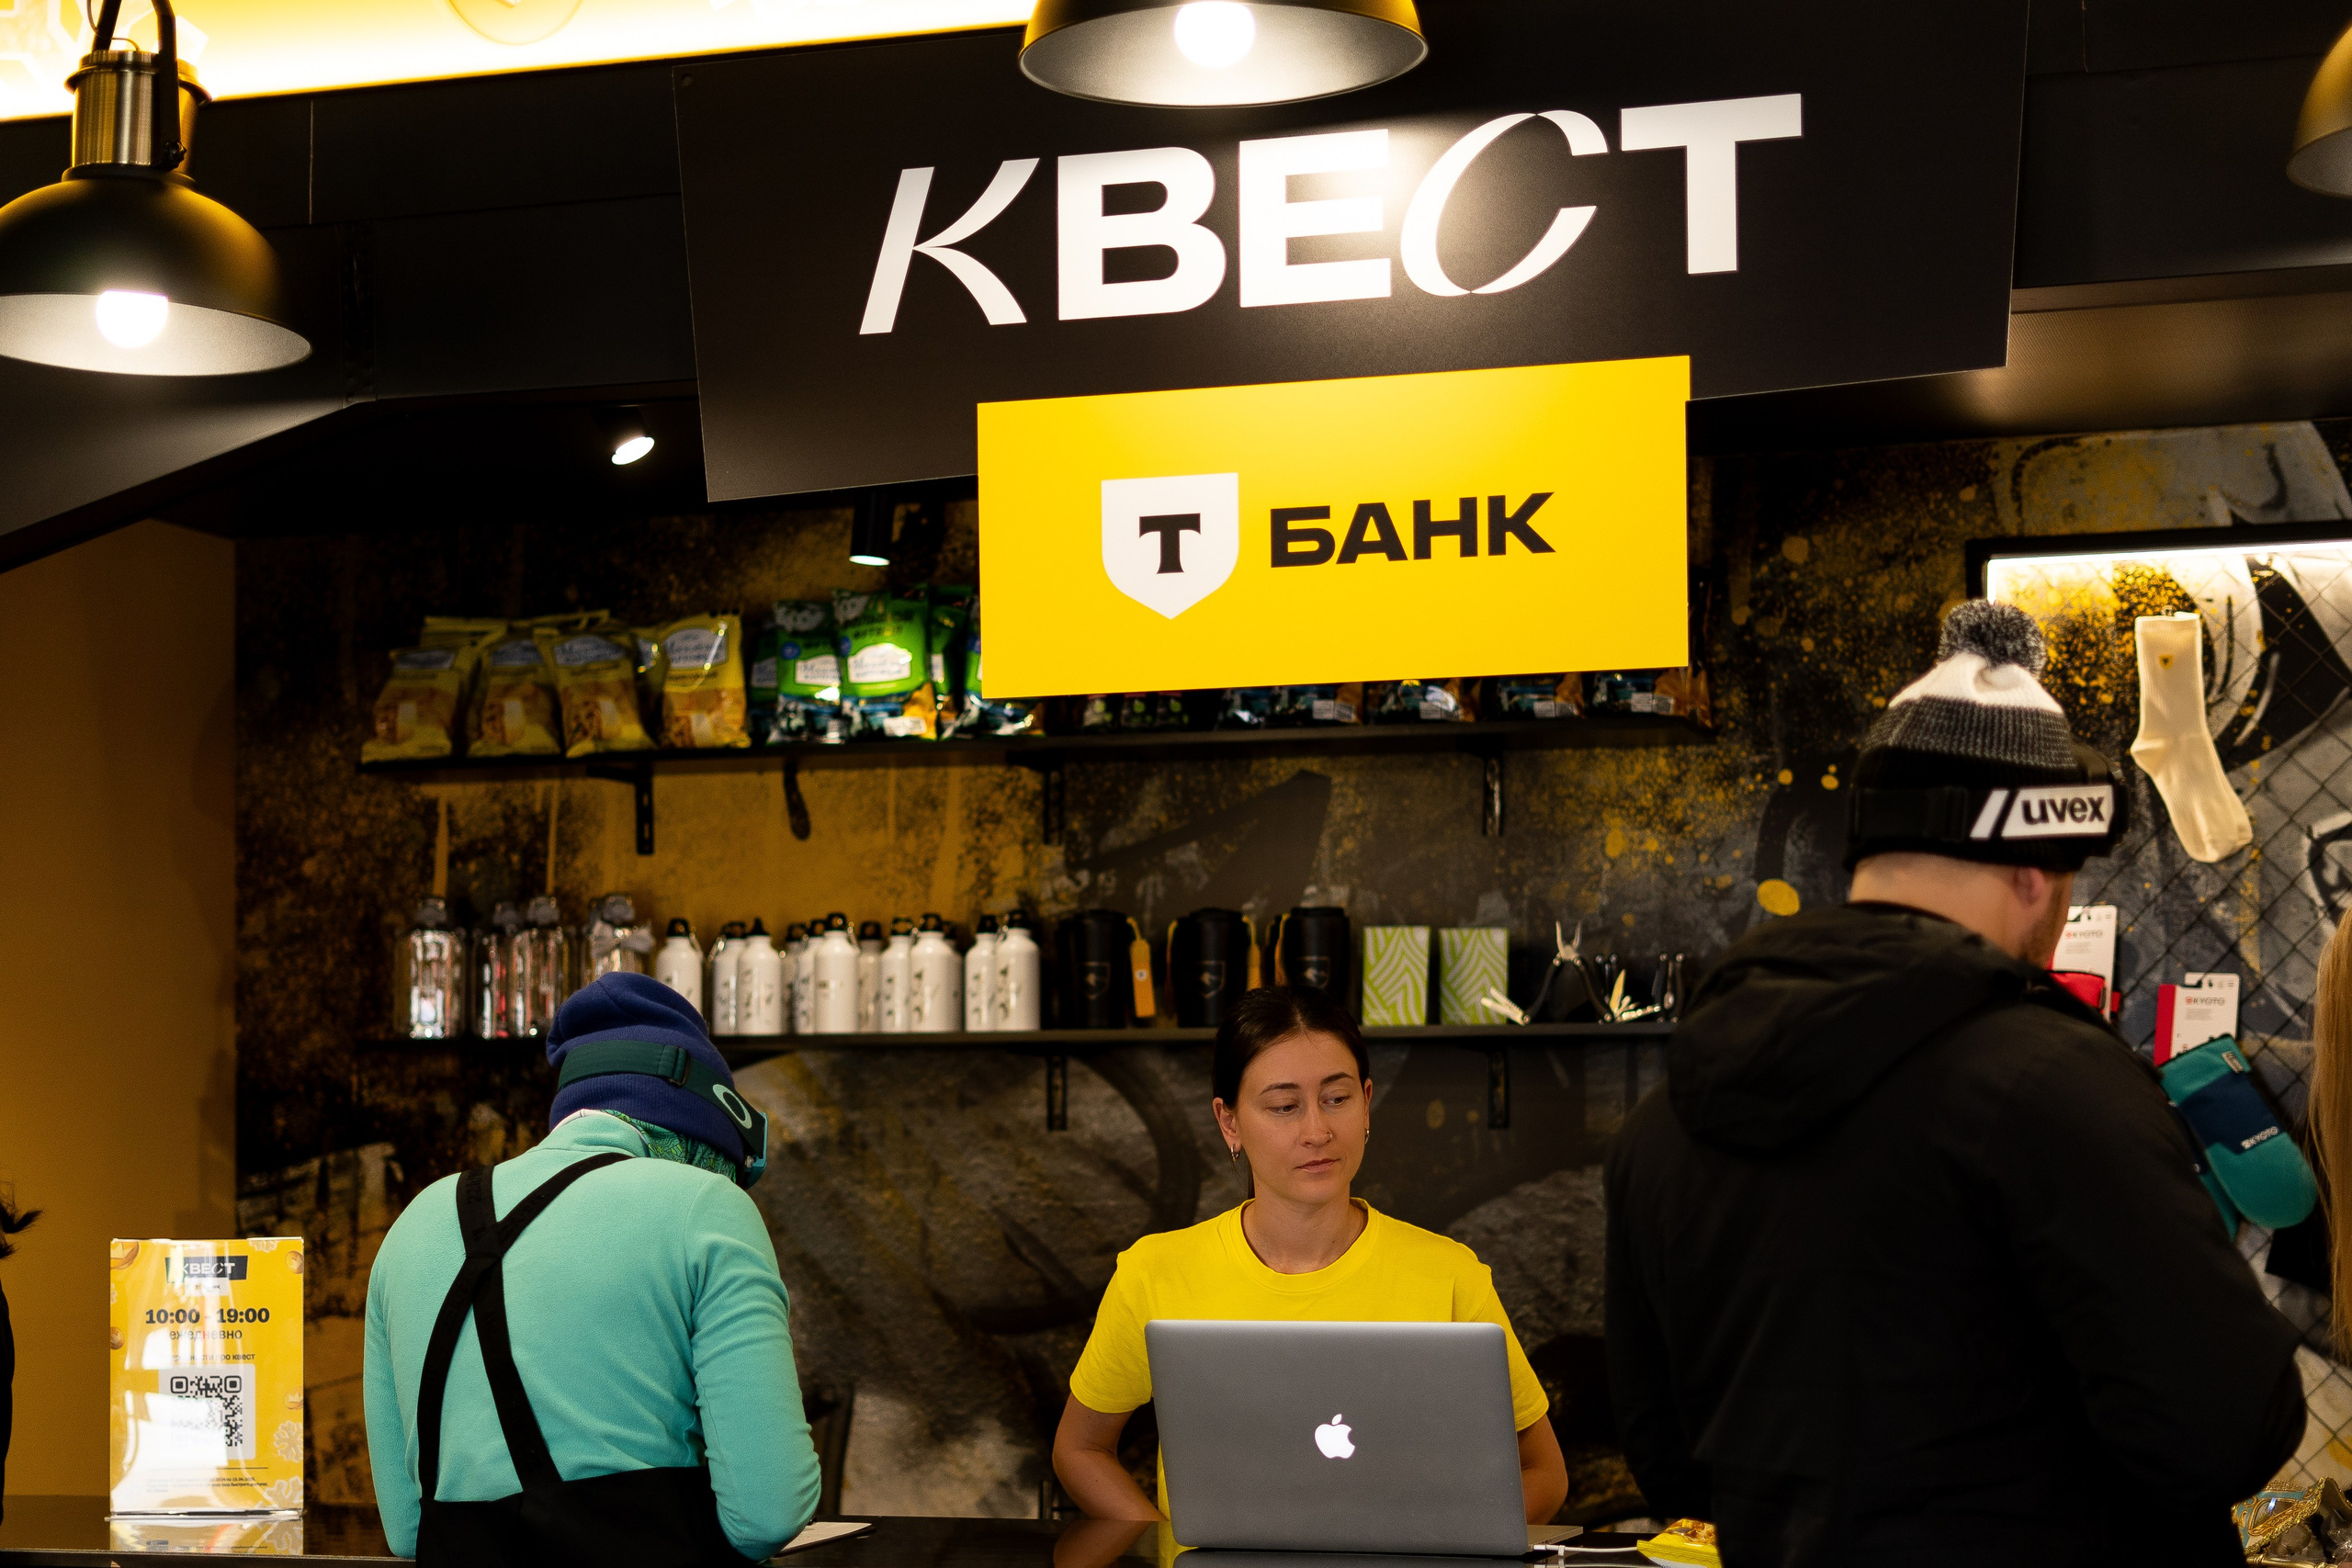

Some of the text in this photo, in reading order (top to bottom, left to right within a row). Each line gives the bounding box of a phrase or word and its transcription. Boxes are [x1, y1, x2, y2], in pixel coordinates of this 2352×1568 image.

[859, 93, 1802, 334] КВЕСТ
[1138, 491, 1556, 575] Т БАНК
[2022, 796, 2105, 825] uvex
[145, 1309, 200, 1324] 10:00
[217, 1307, 270, 1323] 19:00
